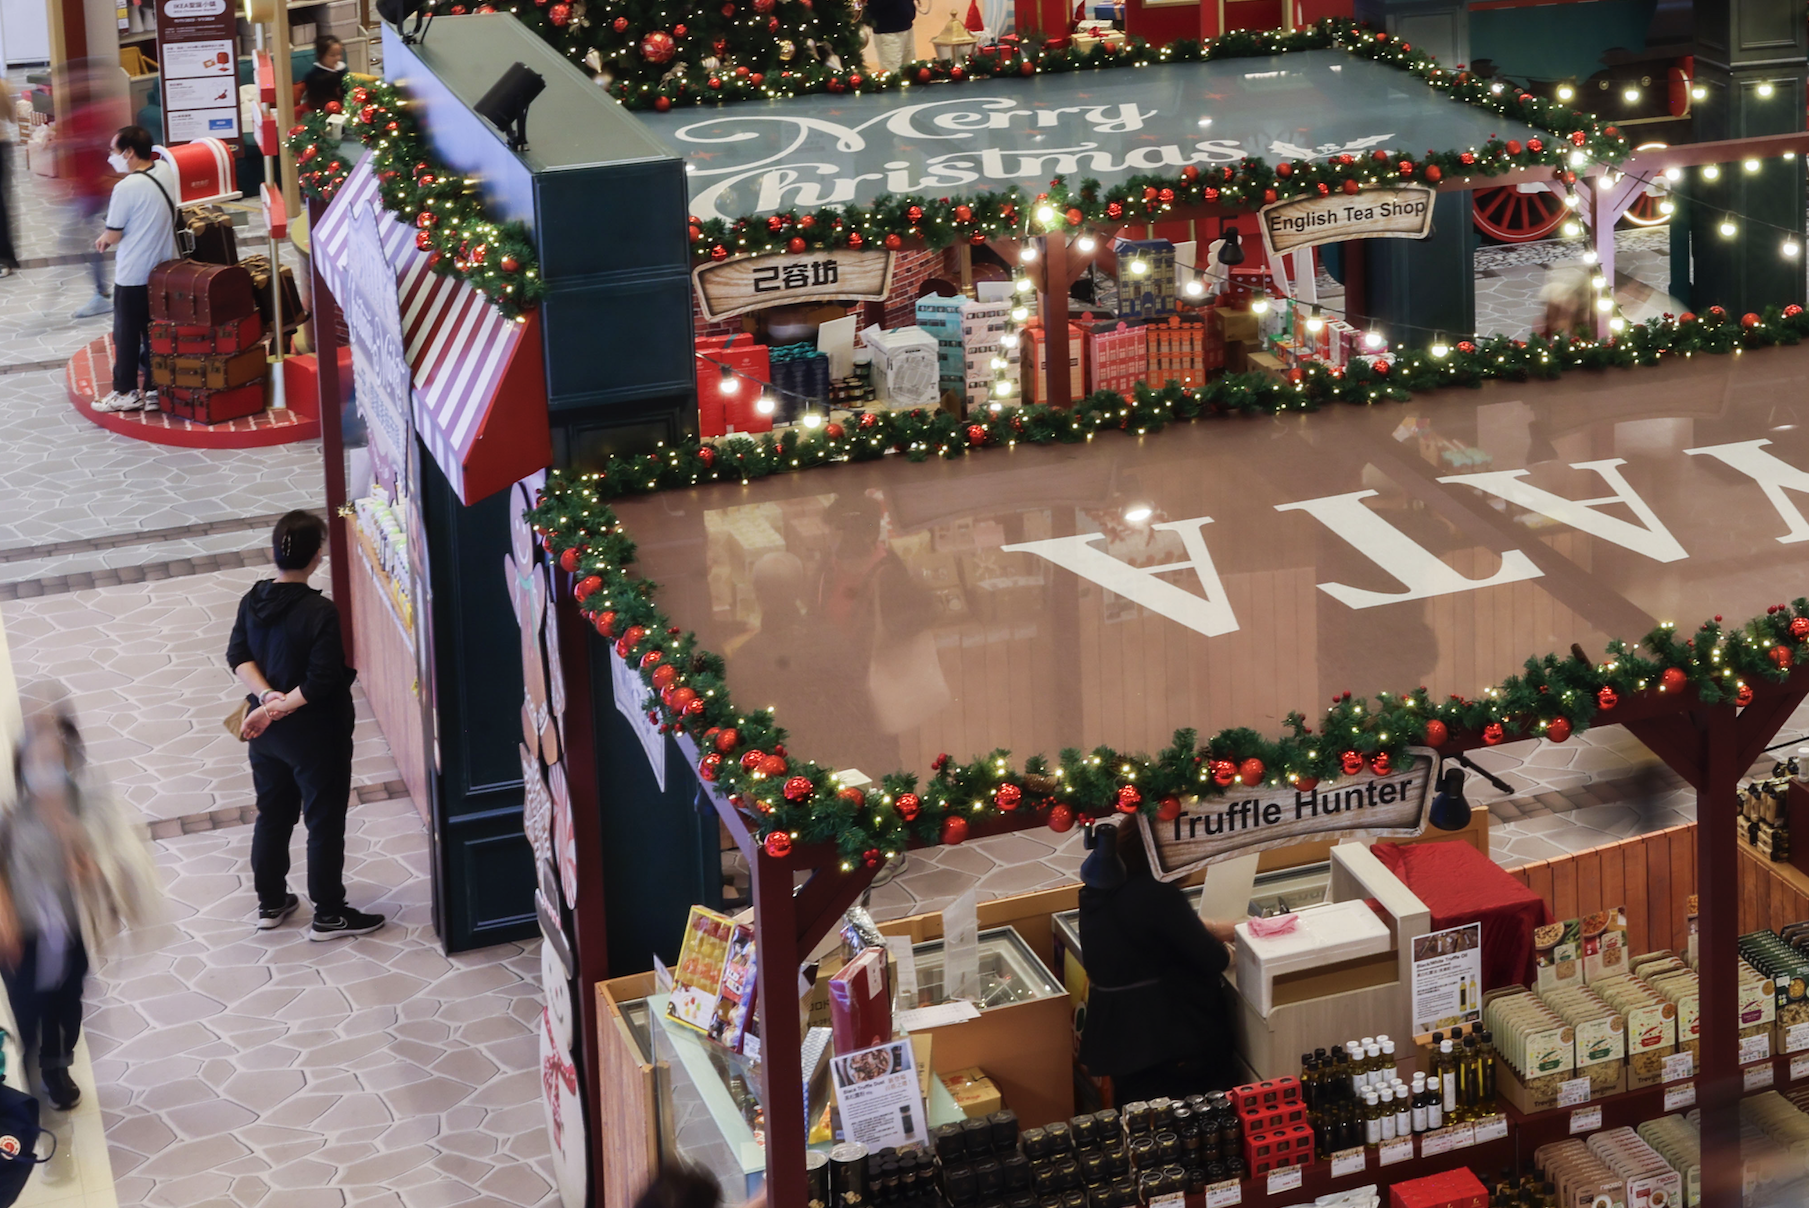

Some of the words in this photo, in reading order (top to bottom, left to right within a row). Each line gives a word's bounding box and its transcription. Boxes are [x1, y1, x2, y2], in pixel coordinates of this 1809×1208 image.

[675, 96, 1158, 177] Merry
[688, 139, 1250, 224] Christmas
[1270, 209, 1338, 233] English
[1343, 206, 1374, 222] Tea
[1379, 200, 1426, 218] Shop
[1173, 798, 1282, 841] Truffle
[1295, 779, 1413, 820] Hunter
